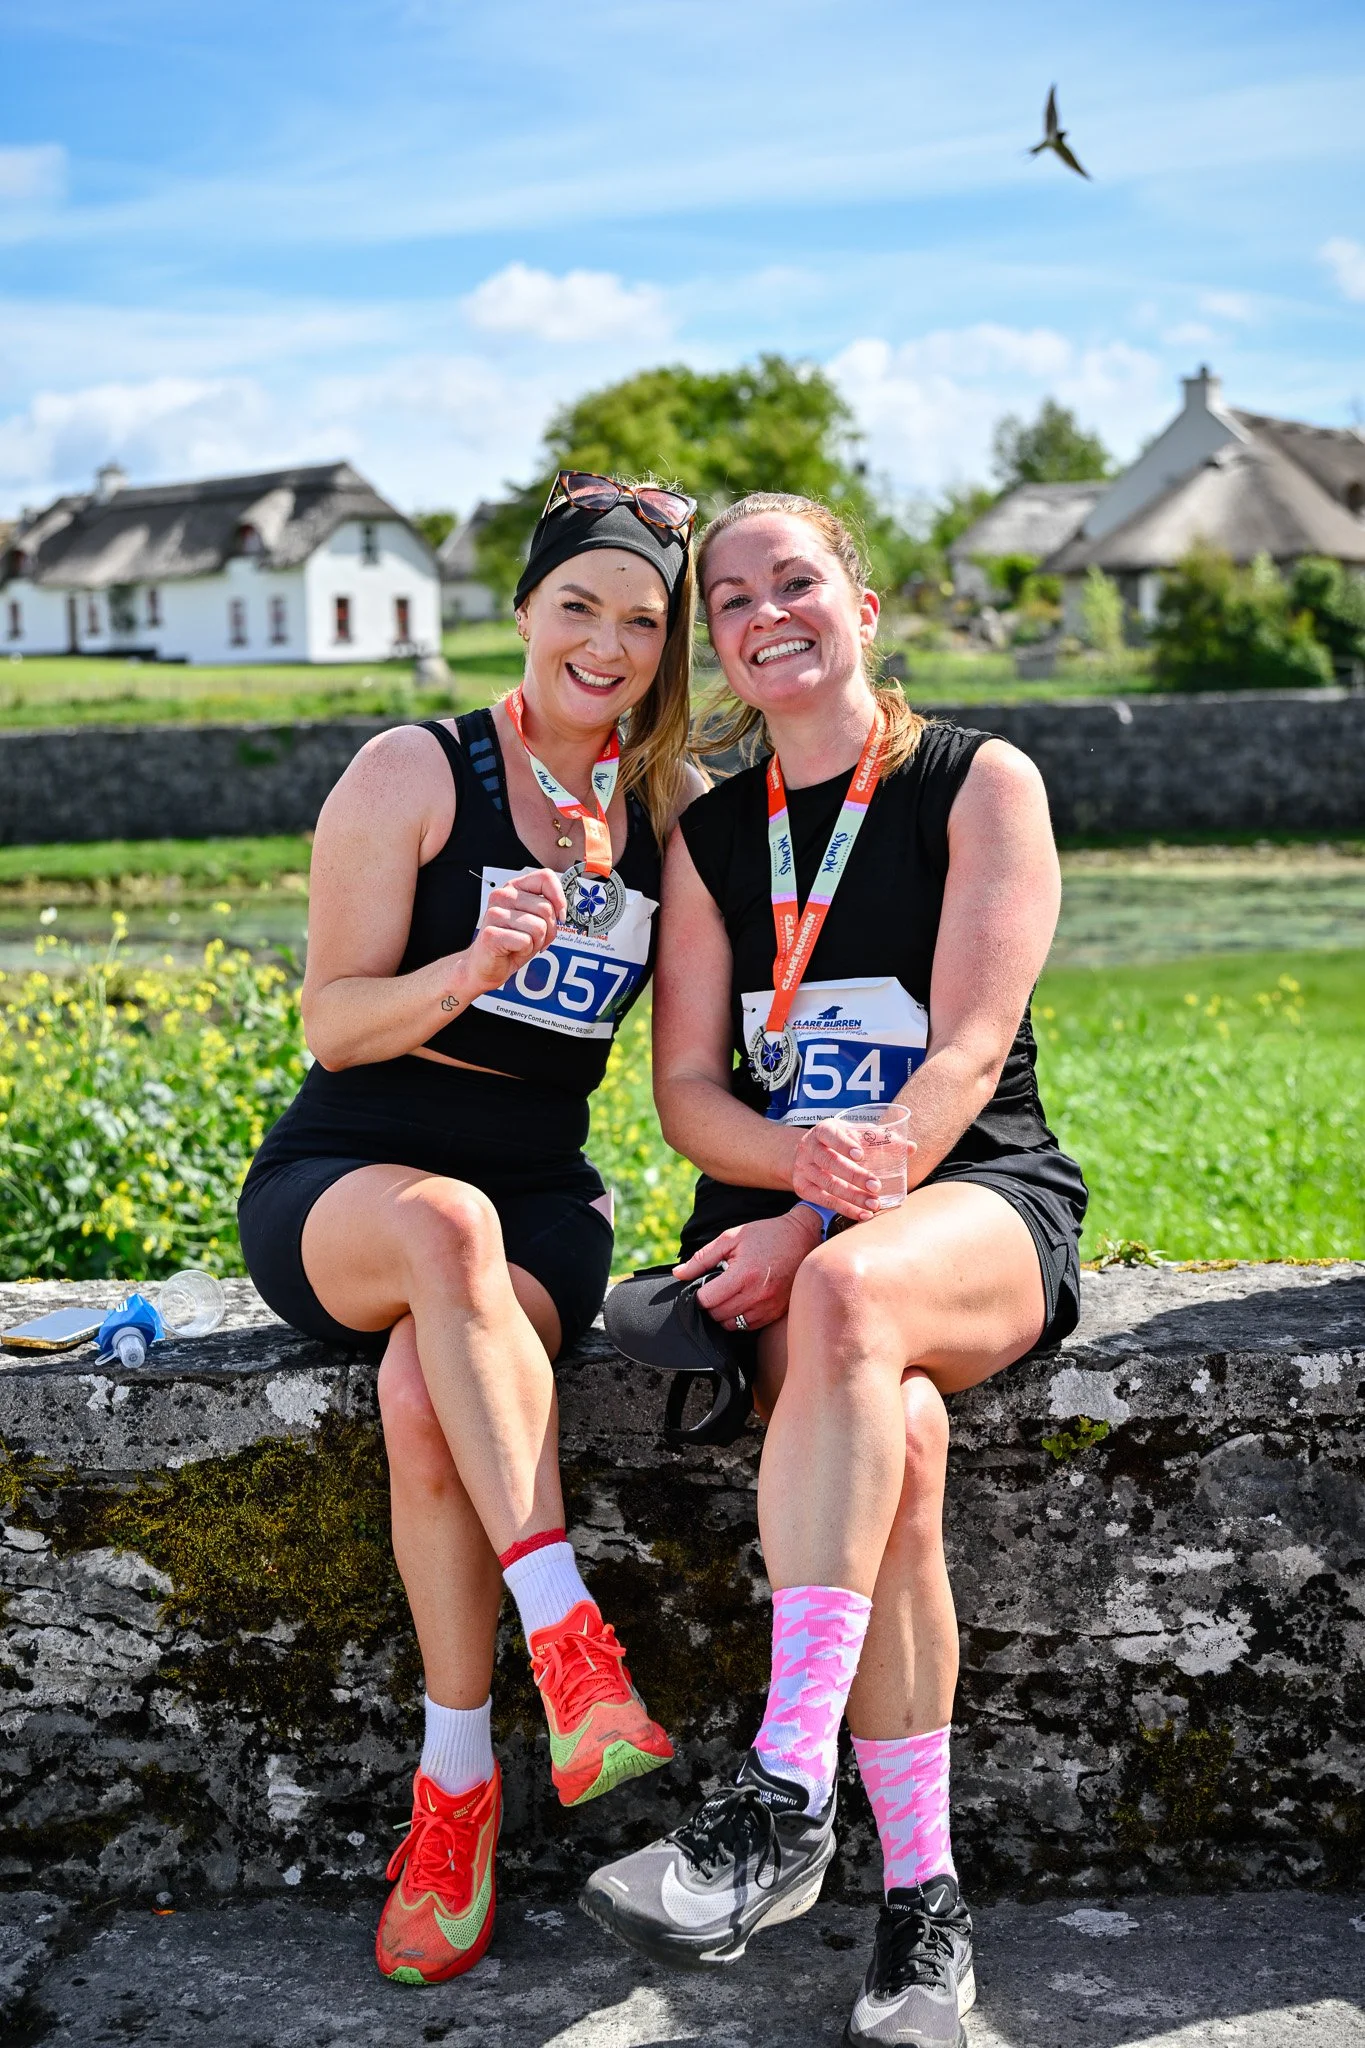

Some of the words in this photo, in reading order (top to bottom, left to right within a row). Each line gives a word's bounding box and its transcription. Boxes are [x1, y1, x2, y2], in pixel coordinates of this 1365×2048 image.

[855, 757, 874, 792] CLARE
[778, 834, 791, 875] MONKS
[822, 832, 848, 873] MONKS
[781, 954, 800, 991] CLARE
[795, 912, 816, 956] BURREN
[497, 949, 629, 1017] 057
[496, 1005, 529, 1020] Emergency
[527, 1014, 551, 1026] Contact
[792, 1019, 822, 1028] CLARE
[823, 1019, 862, 1028] BURREN
[793, 1114, 816, 1122] Contact
[772, 1792, 789, 1804] ZOOM
[788, 1797, 798, 1806] FLY
